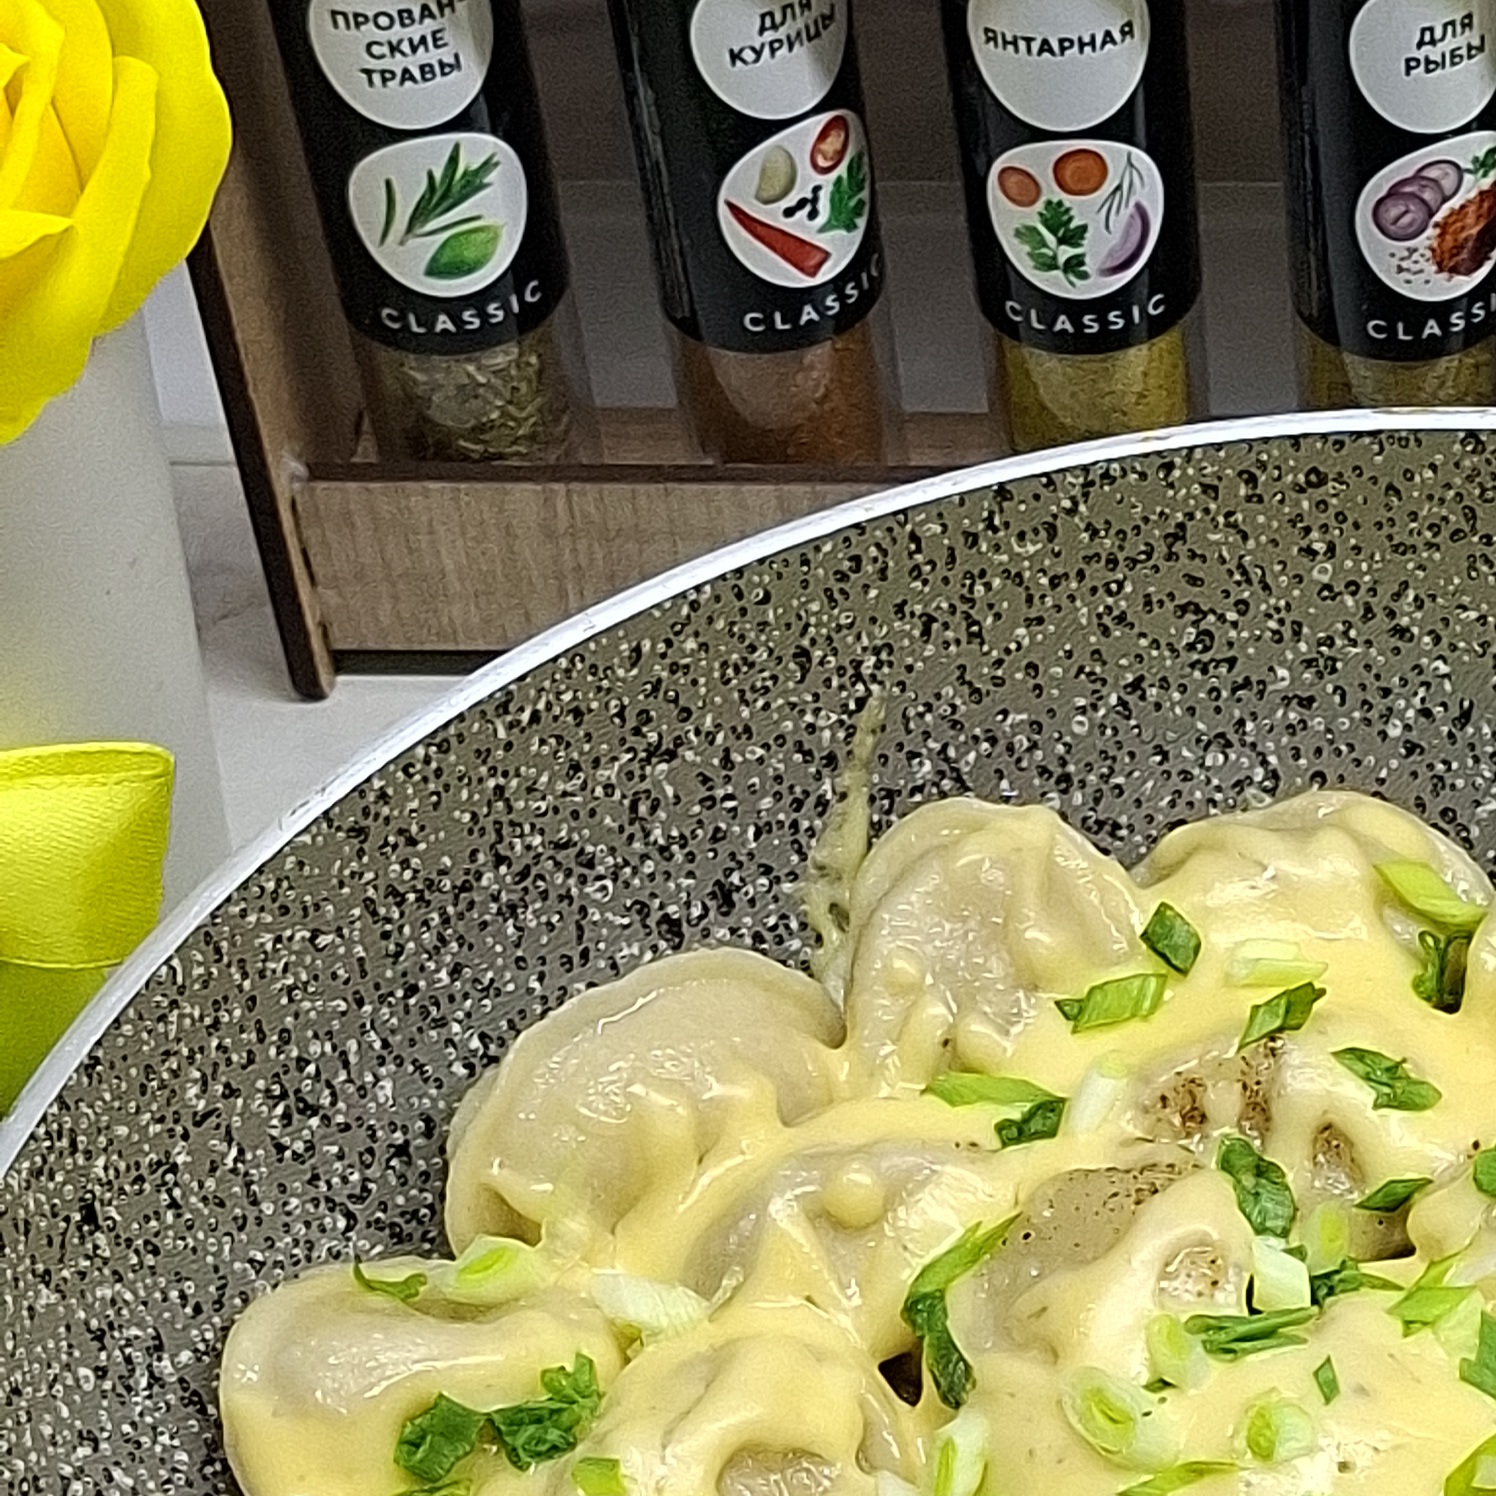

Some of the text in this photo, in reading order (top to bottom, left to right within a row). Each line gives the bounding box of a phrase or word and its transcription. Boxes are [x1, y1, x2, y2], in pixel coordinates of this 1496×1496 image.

[728, 2, 836, 68] КУРИЦЫ
[757, 0, 813, 37] ДЛЯ
[1415, 12, 1475, 51] ДЛЯ
[365, 27, 449, 60] СКИЕ
[982, 20, 1136, 58] ЯНТАРНАЯ
[1403, 34, 1487, 77] РЫБЫ
[359, 51, 463, 89] ТРАВЫ
[380, 280, 542, 333] CLASSIC
[743, 252, 880, 332] CLASSIC
[1004, 294, 1167, 334] CLASSIC
